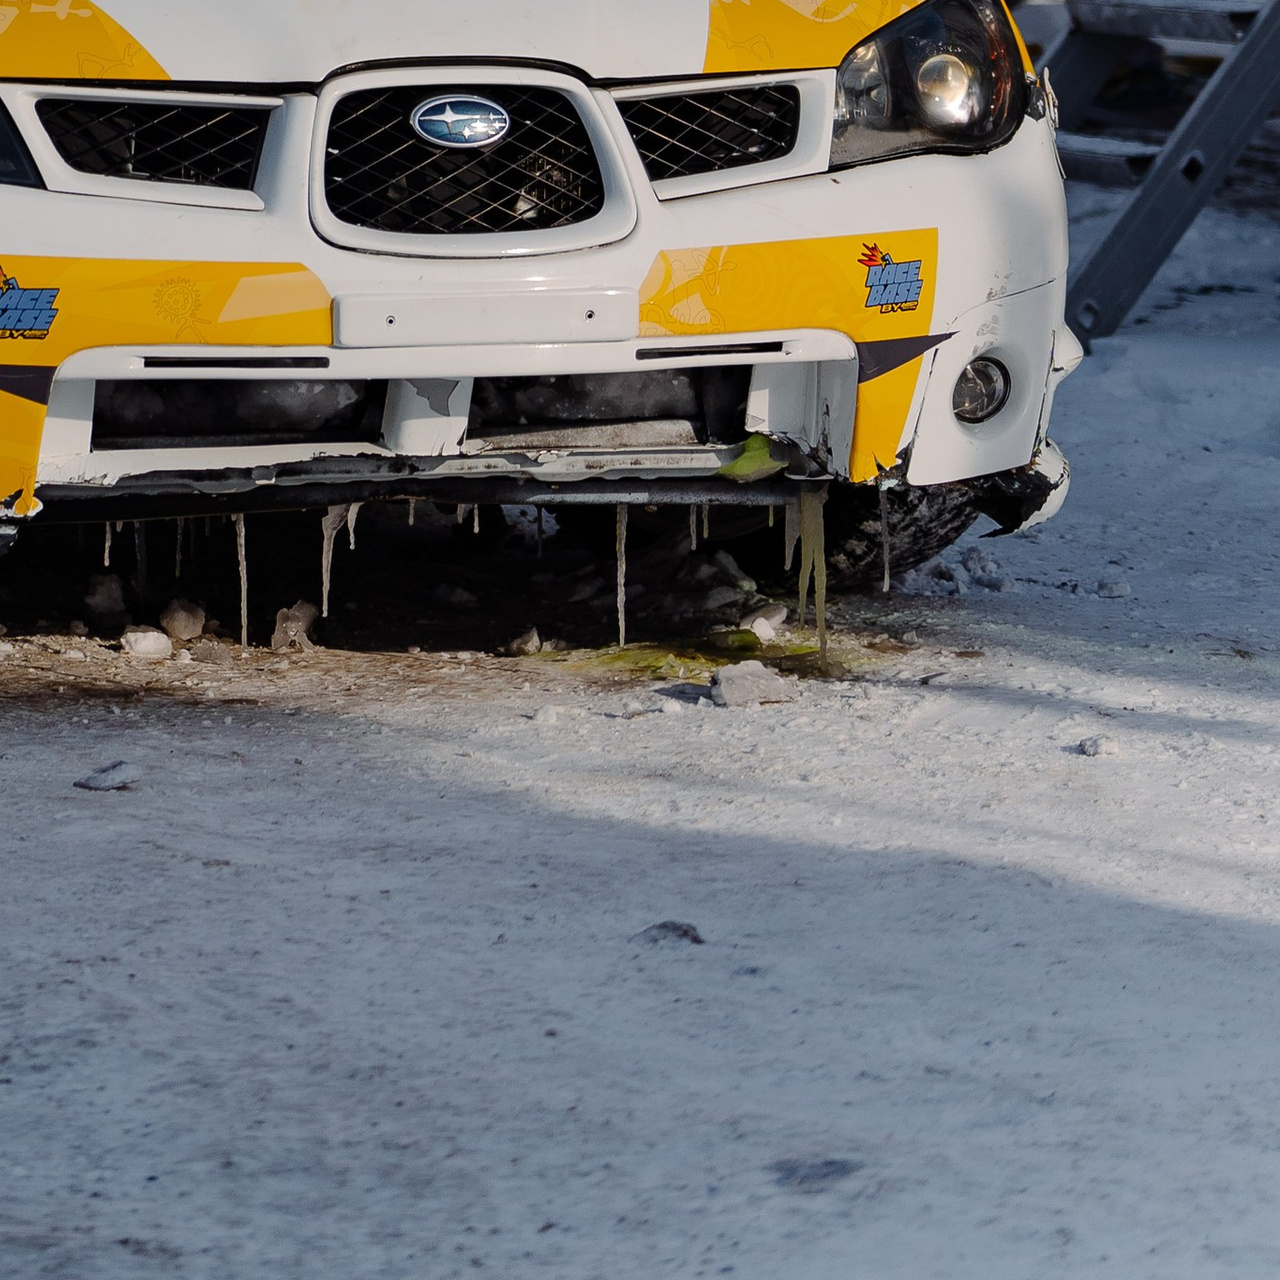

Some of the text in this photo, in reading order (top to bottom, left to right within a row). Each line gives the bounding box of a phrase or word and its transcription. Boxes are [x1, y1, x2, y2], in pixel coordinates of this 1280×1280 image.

[865, 260, 921, 287] RACE
[865, 280, 923, 307] BASE
[881, 303, 902, 313] BY
